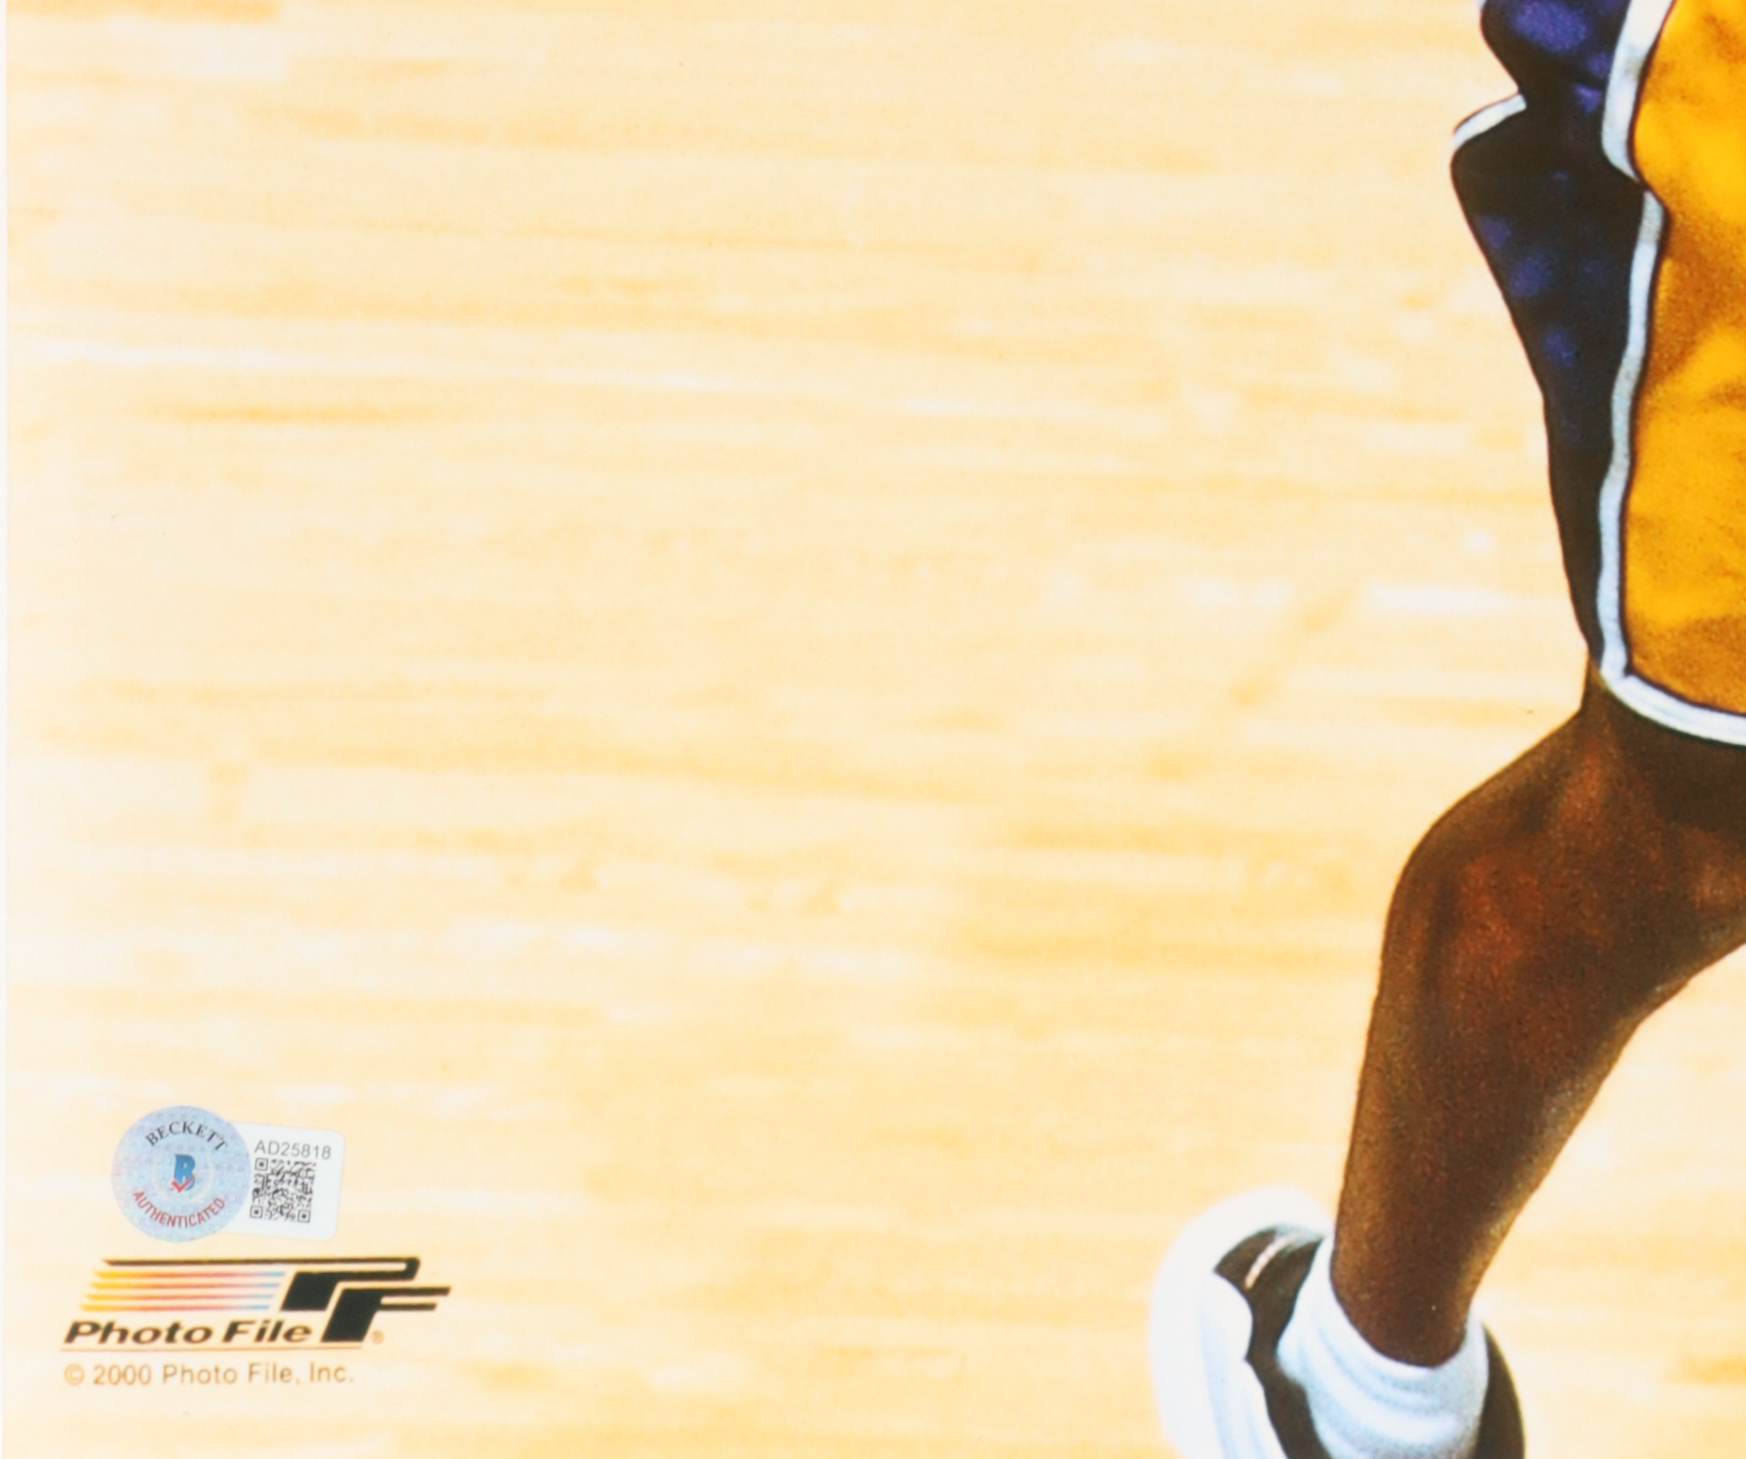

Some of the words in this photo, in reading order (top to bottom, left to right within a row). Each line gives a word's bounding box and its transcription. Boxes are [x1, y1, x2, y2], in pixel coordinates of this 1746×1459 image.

[145, 1120, 229, 1152] BECKETT
[254, 1139, 332, 1161] AD25818
[133, 1189, 226, 1229] AUTHENTICATED
[63, 1320, 214, 1345] Photo
[222, 1319, 313, 1344] File
[93, 1364, 152, 1385] 2000
[162, 1362, 238, 1384] Photo
[248, 1361, 300, 1386] File,
[308, 1361, 355, 1383] Inc.
